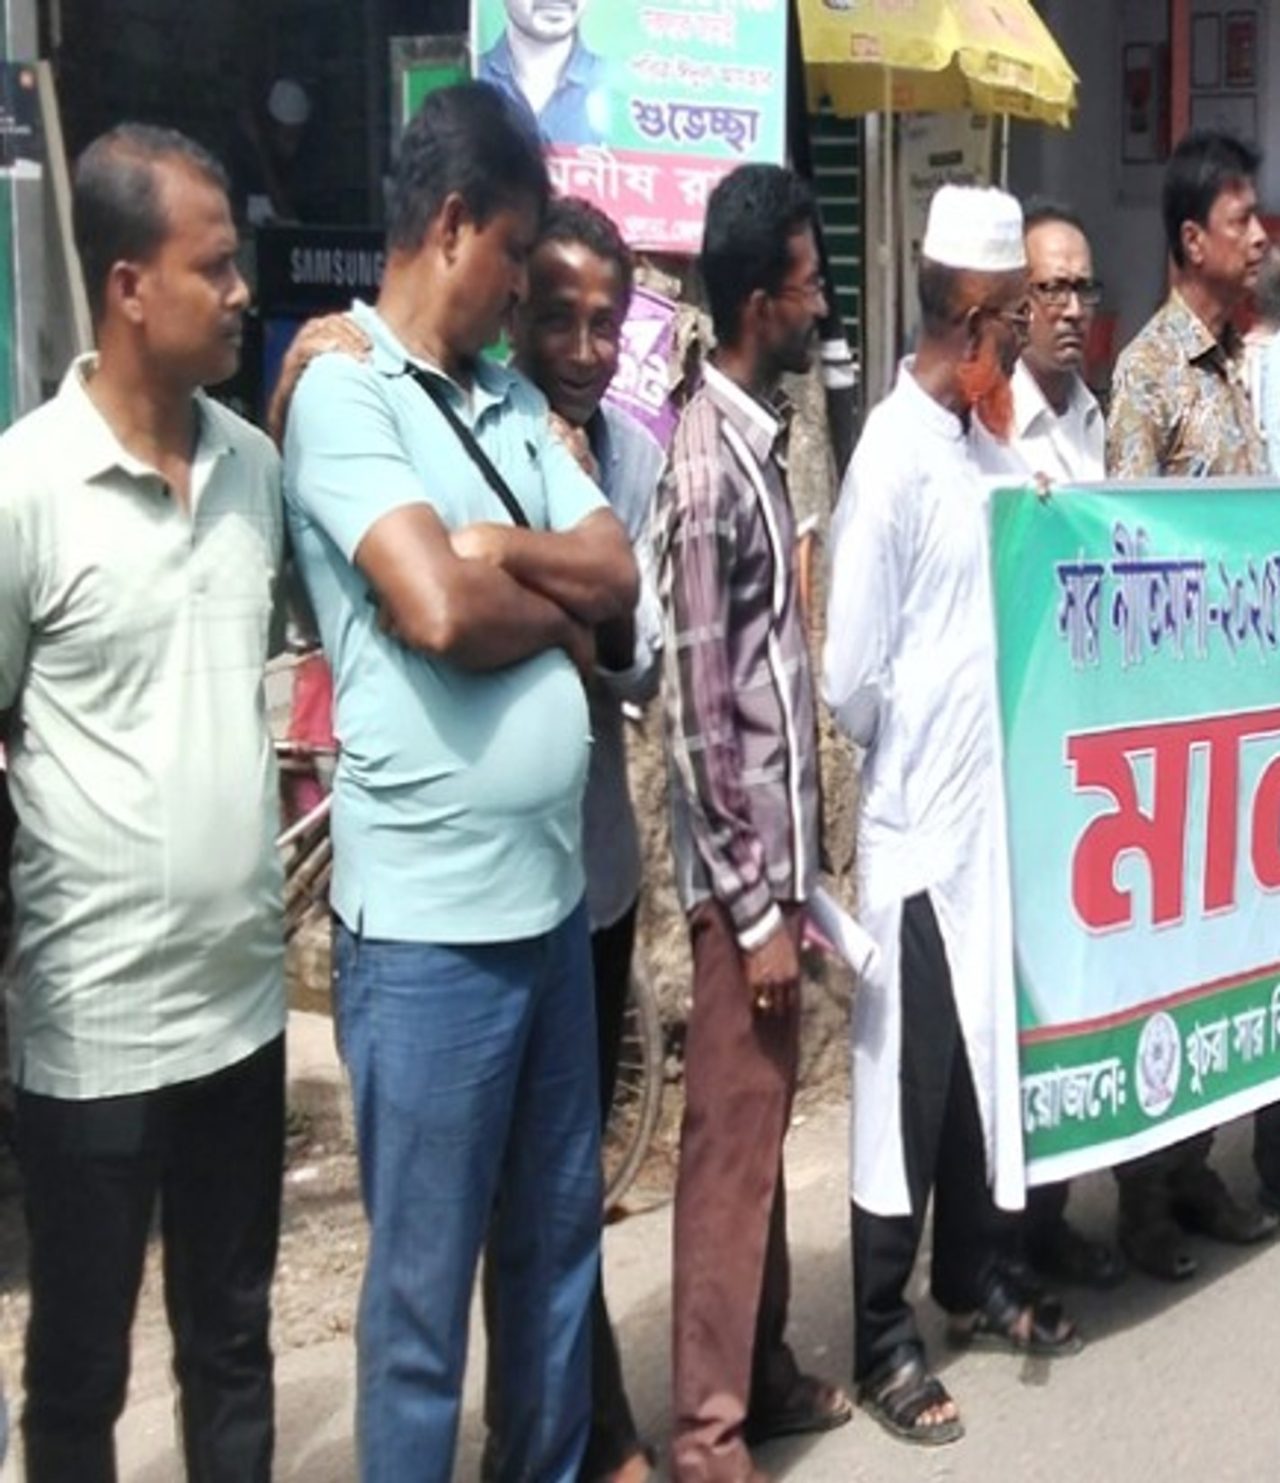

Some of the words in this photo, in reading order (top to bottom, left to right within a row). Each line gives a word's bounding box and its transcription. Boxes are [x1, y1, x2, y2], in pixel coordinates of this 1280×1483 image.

[631, 99, 760, 153] শুভেচ্ছা
[1056, 558, 1104, 669] সার
[1022, 1057, 1126, 1133] য়োজনে:
[1186, 1015, 1229, 1095] খুচরা
[1233, 1007, 1266, 1063] সার
